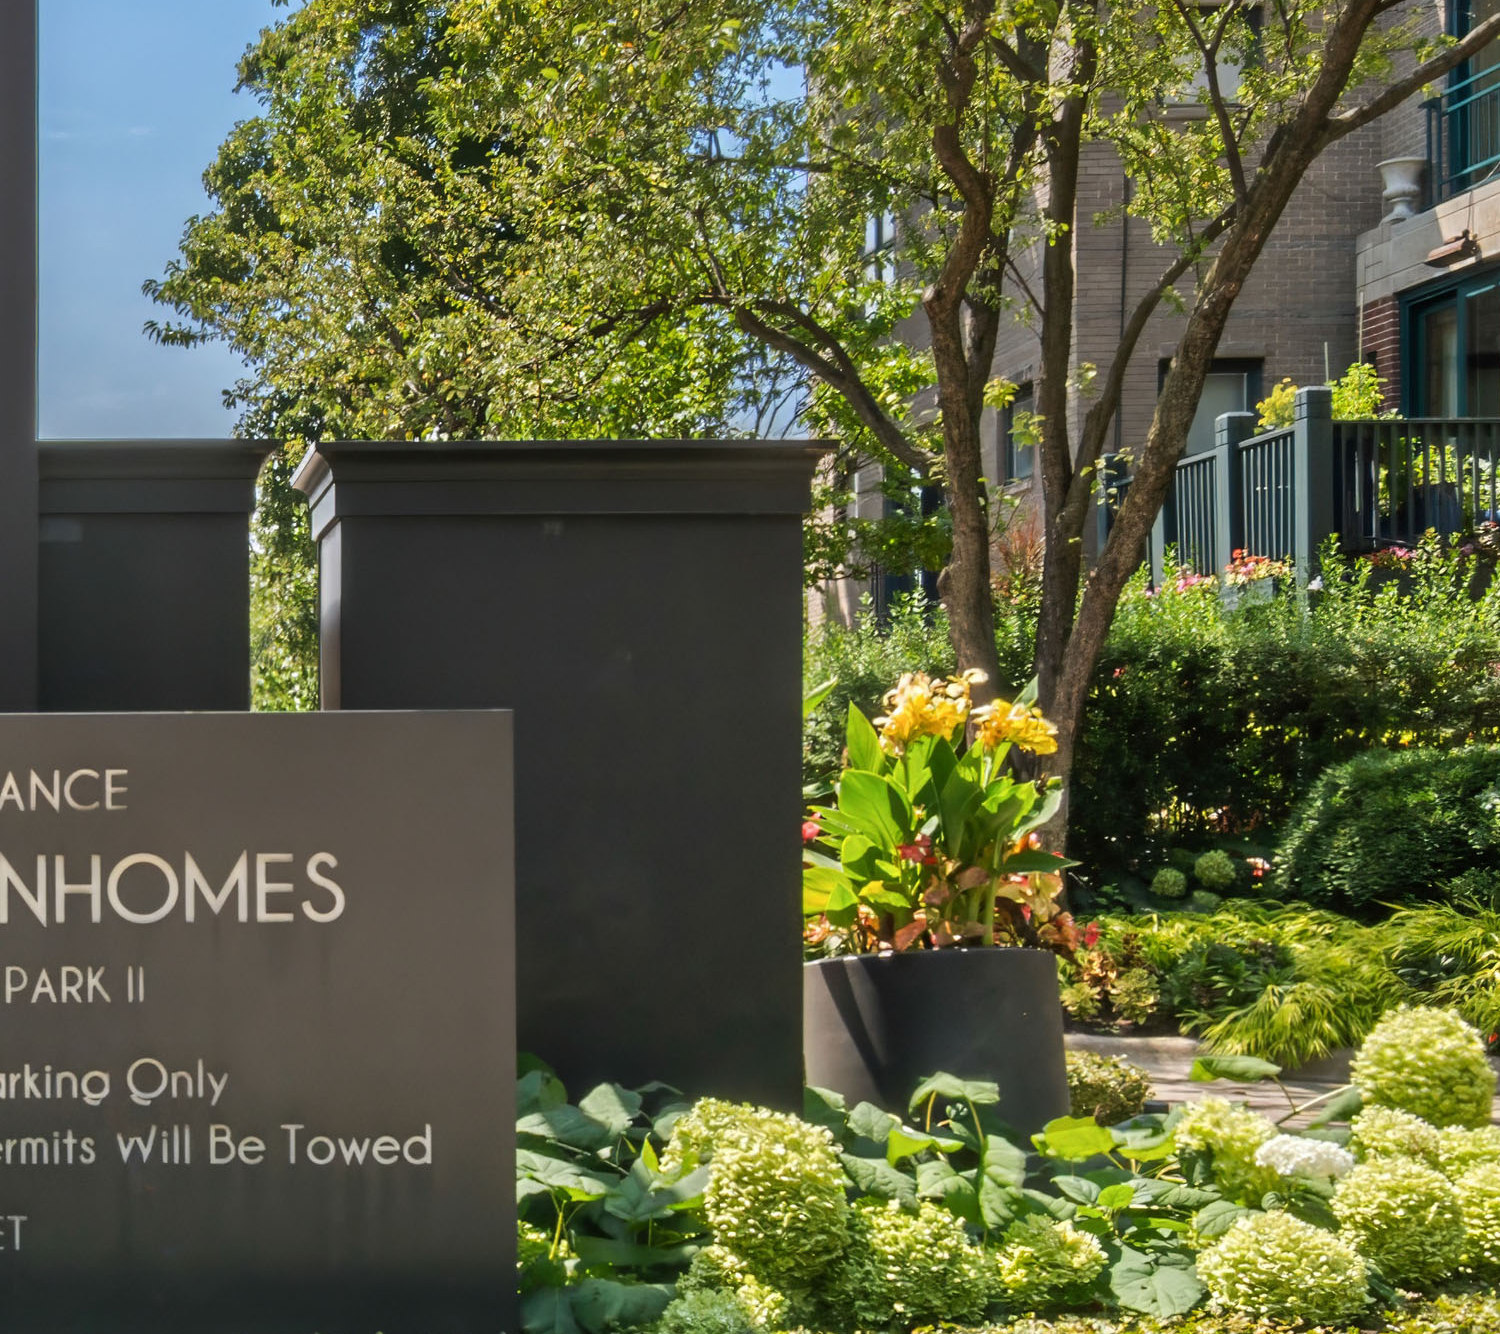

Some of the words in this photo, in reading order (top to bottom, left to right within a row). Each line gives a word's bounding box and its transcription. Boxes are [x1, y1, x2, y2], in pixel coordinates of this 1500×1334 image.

[5, 965, 111, 1004] PARK
[127, 965, 145, 1003] II
[126, 1056, 228, 1107] Only
[116, 1124, 191, 1165] Will
[209, 1124, 266, 1165] Be
[280, 1123, 433, 1166] Towed
